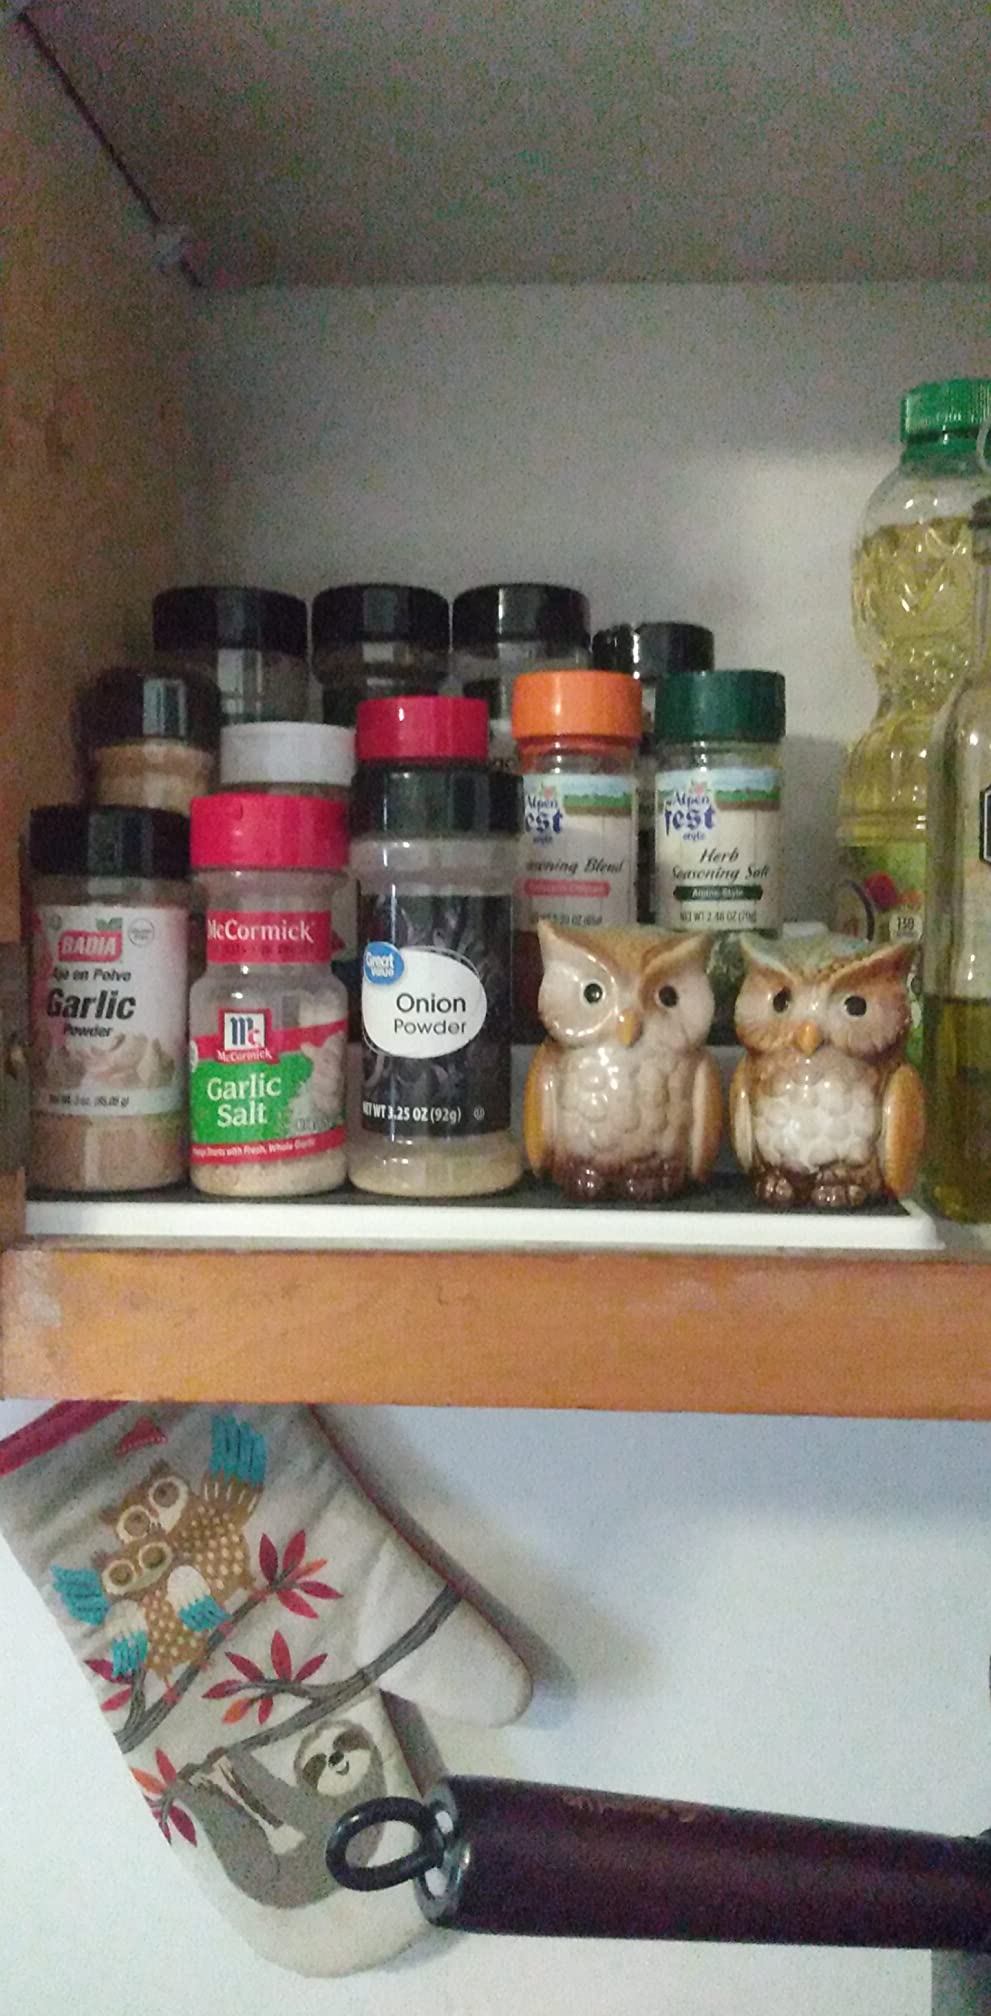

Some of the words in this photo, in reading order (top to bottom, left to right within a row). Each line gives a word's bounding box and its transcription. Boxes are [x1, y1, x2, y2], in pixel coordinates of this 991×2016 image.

[674, 792, 709, 811] Alpen
[584, 856, 624, 873] Blend
[700, 848, 739, 863] Herb
[672, 864, 740, 884] Seasoning
[694, 911, 705, 921] WT
[726, 911, 737, 922] OZ
[207, 919, 314, 944] McCormick
[62, 936, 116, 955] BADIA
[366, 951, 394, 969] Great
[73, 970, 89, 981] en
[94, 968, 132, 982] Polvo
[371, 966, 394, 978] Value
[47, 988, 136, 1020] Garlic
[396, 992, 467, 1014] Onion
[64, 1023, 113, 1037] Powder
[394, 1018, 468, 1035] Powder
[216, 1048, 274, 1063] McCormick
[206, 1073, 282, 1101] Garlic
[216, 1102, 268, 1128] Salt
[363, 1101, 373, 1117] NET
[373, 1104, 387, 1119] WT
[388, 1106, 410, 1121] 3.25
[412, 1107, 428, 1122] OZ
[430, 1106, 462, 1125] (92g)
